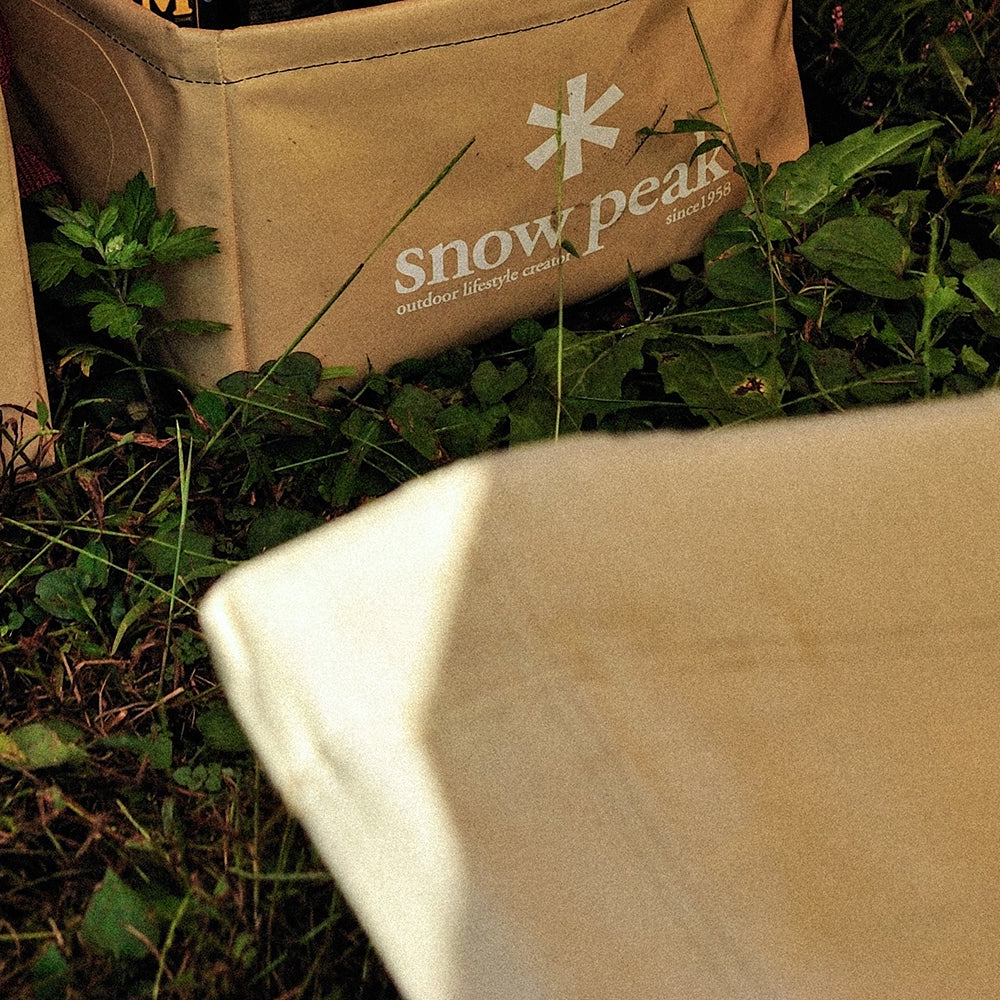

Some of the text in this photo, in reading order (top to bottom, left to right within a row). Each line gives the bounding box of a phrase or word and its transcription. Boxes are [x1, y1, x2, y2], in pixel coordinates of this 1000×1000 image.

[394, 131, 730, 294] snow peak
[665, 181, 732, 225] since1958
[396, 253, 572, 315] outdoor lifestyle creator
